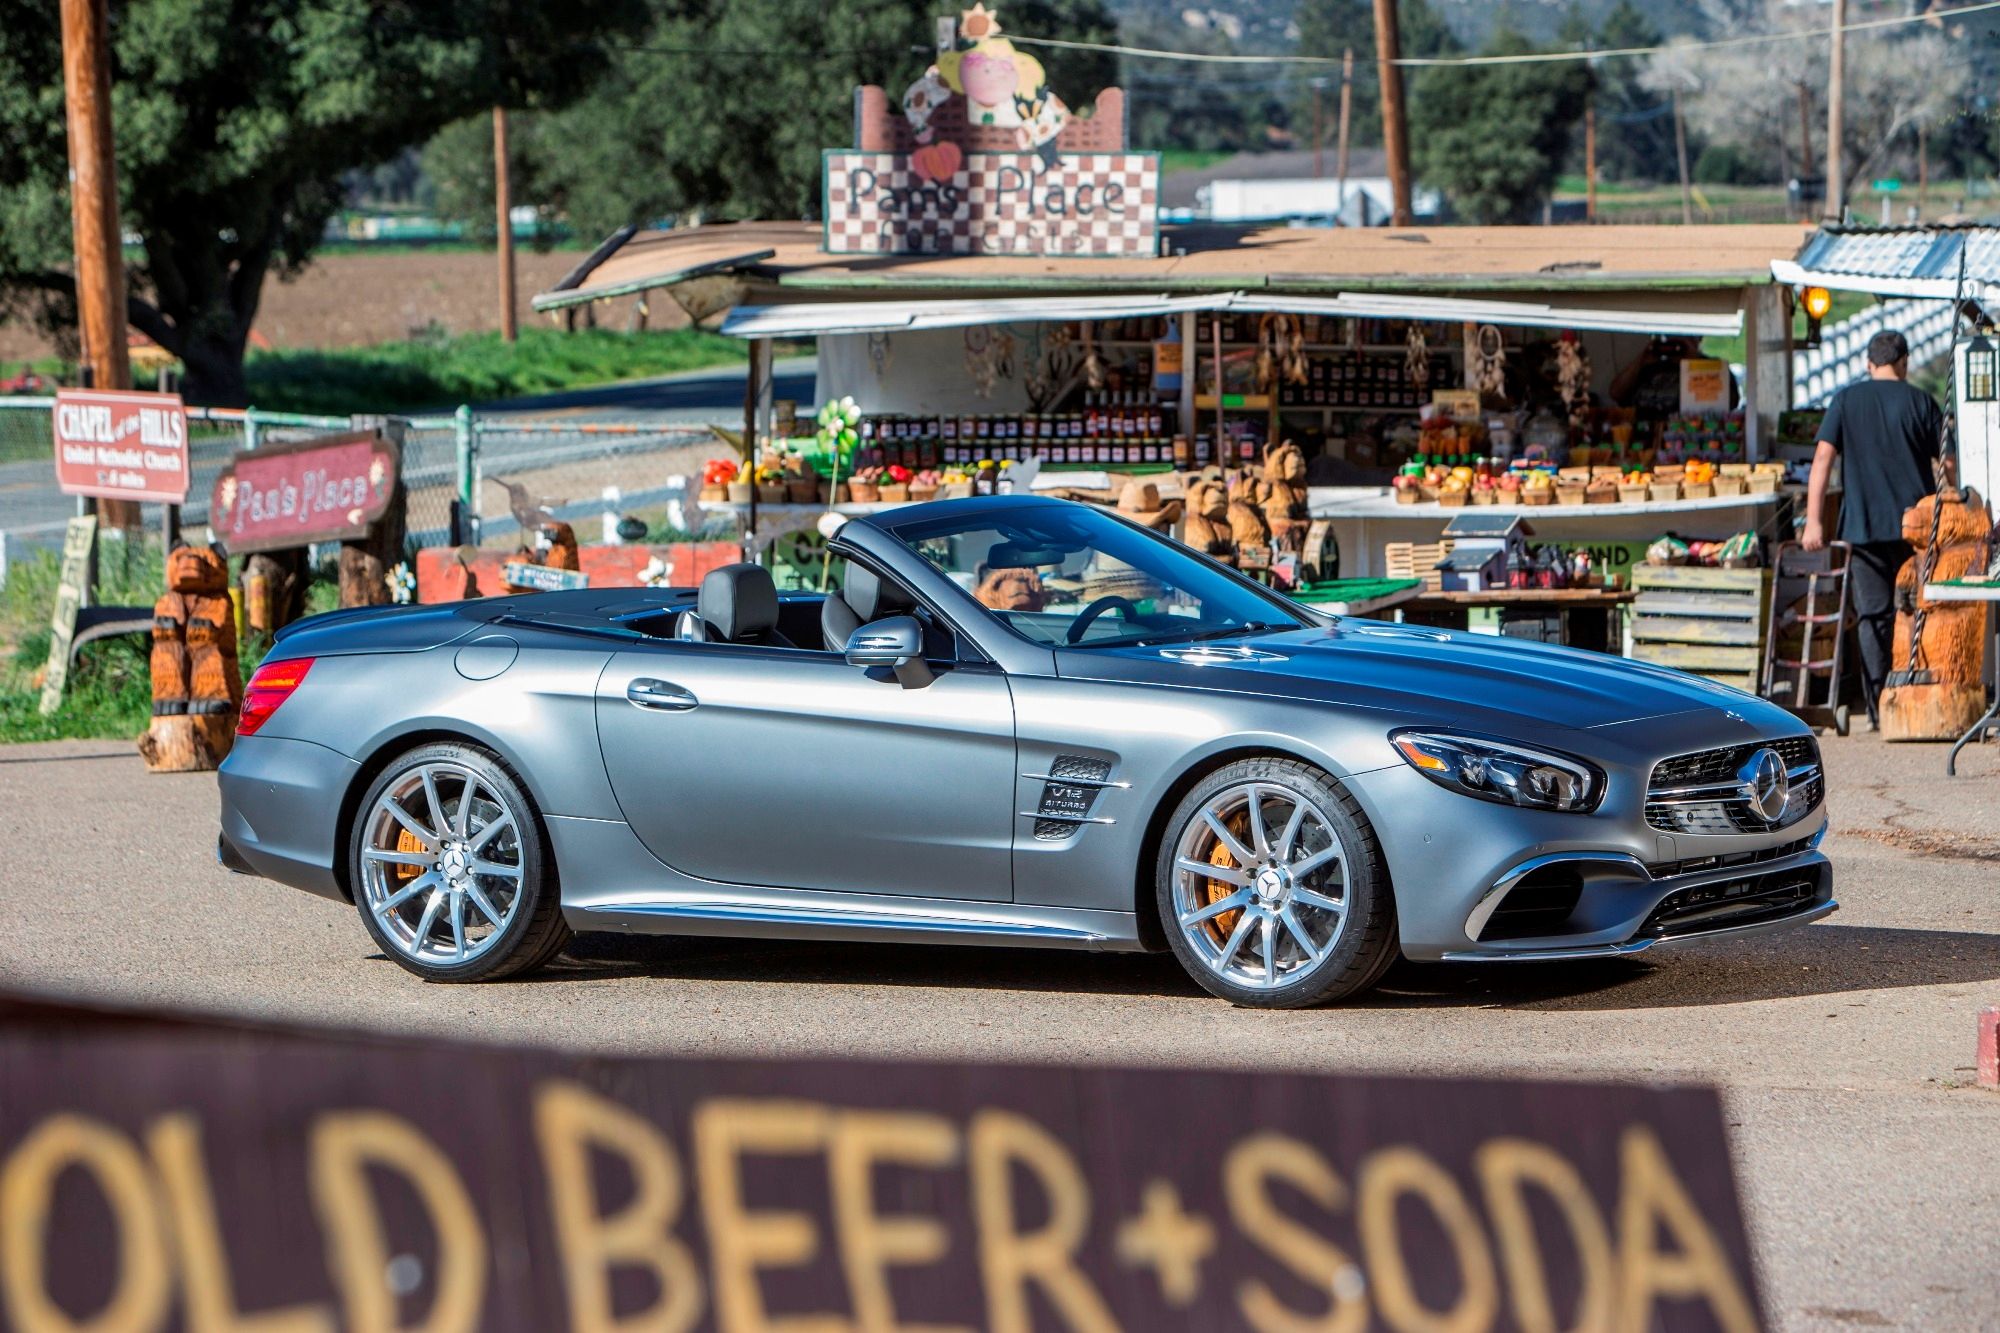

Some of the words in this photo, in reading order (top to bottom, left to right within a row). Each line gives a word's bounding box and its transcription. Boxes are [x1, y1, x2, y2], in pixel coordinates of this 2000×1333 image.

[994, 165, 1126, 216] Place
[58, 403, 115, 443] CHAPEL
[139, 407, 182, 449] HILLS
[144, 450, 182, 473] Church
[299, 468, 368, 524] Place
[1051, 788, 1083, 799] V12
[1192, 764, 1248, 801] MICHELIN
[1045, 799, 1086, 810] BITURBO
[534, 1078, 1120, 1333] BEER
[1222, 1124, 1758, 1333] SODA
